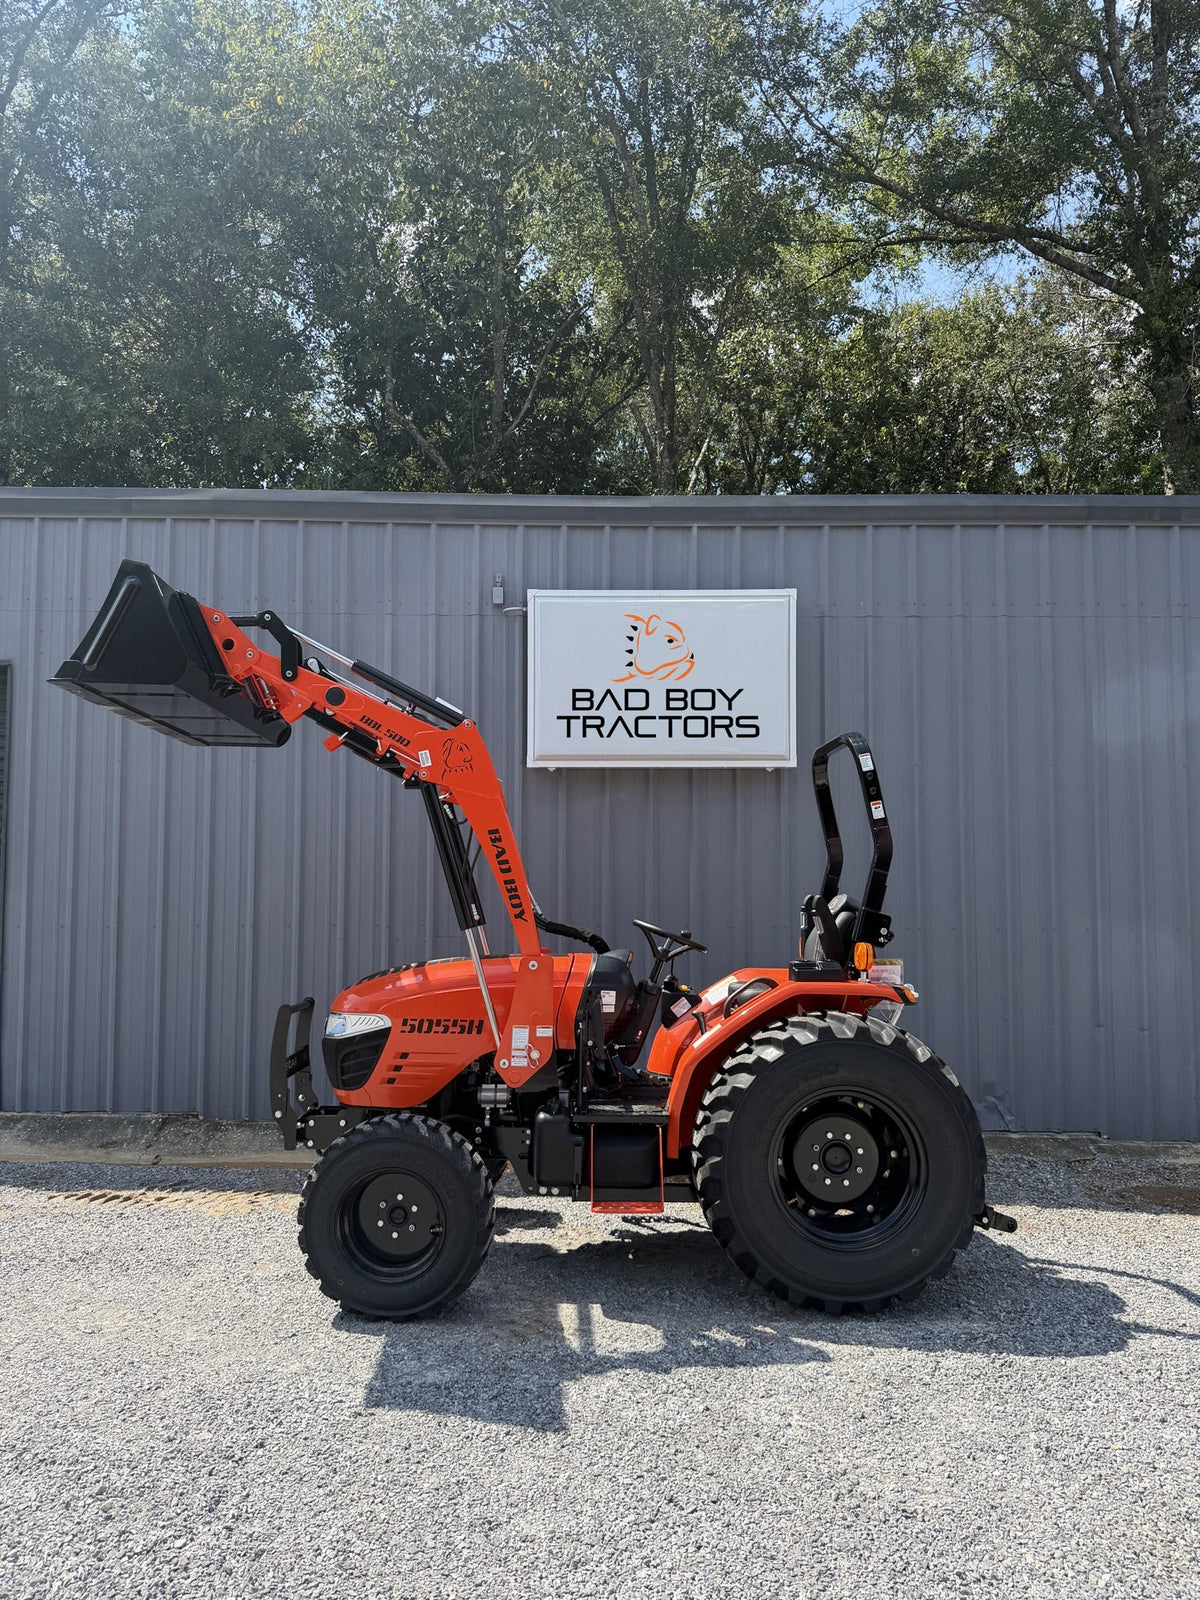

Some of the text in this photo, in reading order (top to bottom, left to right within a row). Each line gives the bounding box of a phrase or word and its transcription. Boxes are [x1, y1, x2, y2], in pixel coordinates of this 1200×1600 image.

[571, 688, 745, 711] BAD BOY
[359, 714, 411, 748] BBL 500
[556, 715, 760, 739] TRACTORS
[487, 828, 528, 923] BAD BOY
[400, 1018, 485, 1035] 5055H
